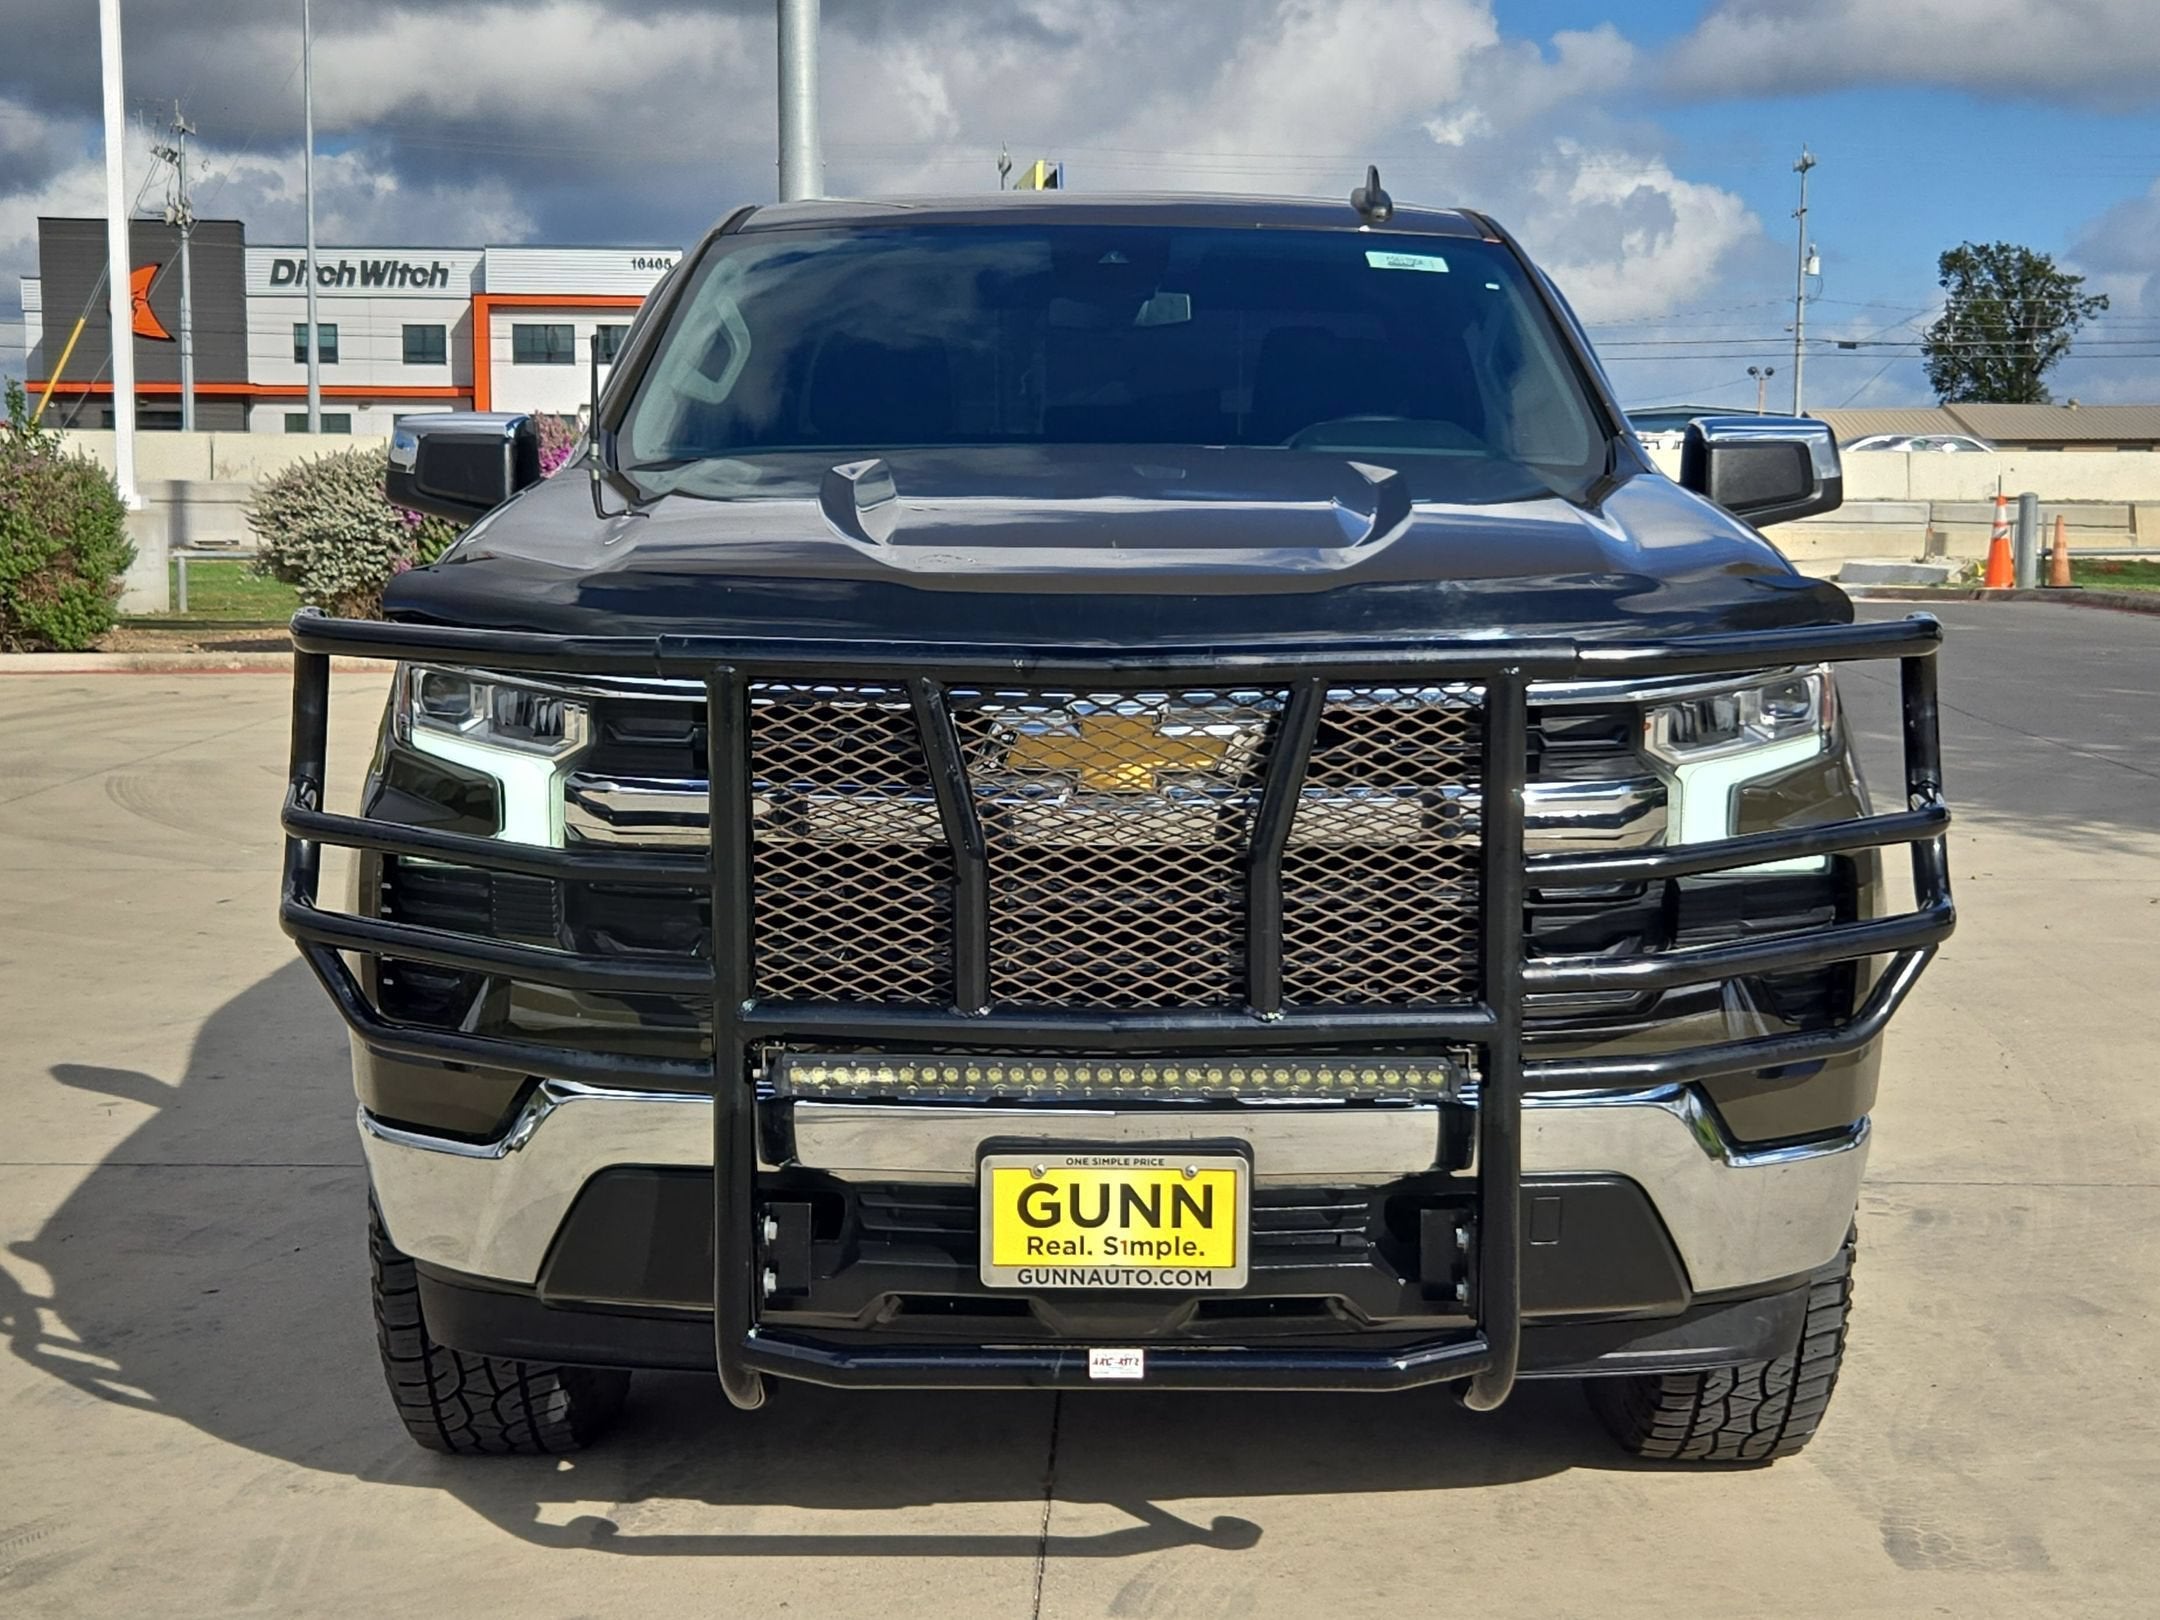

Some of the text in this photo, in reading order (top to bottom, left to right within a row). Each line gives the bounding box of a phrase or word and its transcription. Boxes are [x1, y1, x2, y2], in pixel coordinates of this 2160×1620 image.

[360, 259, 449, 288] Witch
[1065, 1157, 1165, 1167] ONE SIMPLE PRICE
[1016, 1182, 1214, 1229] GUNN
[1026, 1235, 1093, 1256] Real.
[1017, 1268, 1213, 1287] GUNNAUTO.COM
